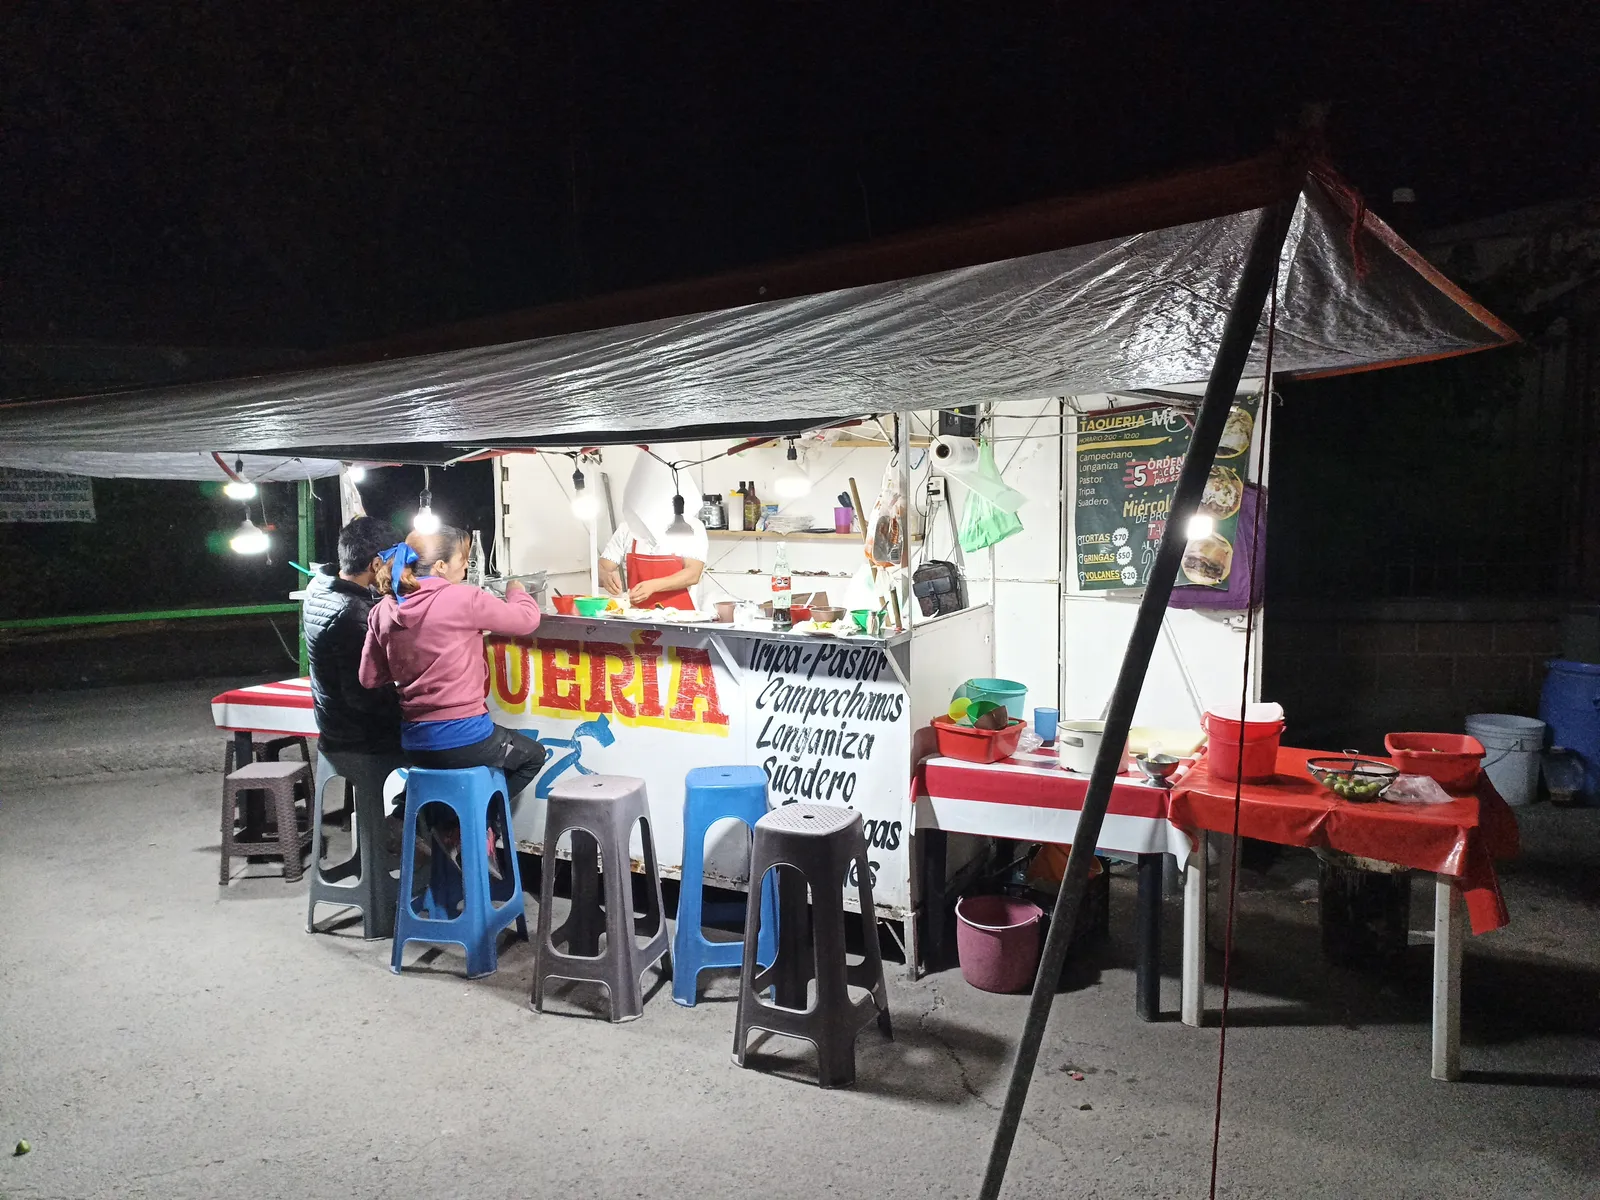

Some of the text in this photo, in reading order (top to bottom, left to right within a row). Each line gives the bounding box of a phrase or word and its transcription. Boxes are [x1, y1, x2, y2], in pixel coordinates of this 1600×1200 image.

[1080, 415, 1146, 432] TAQUERIA
[1079, 451, 1133, 463] Campechano
[1079, 462, 1119, 473] Longaniza
[1152, 464, 1181, 479] TACOS
[1079, 476, 1103, 485] Pastor
[1133, 465, 1147, 486] 5
[1153, 477, 1168, 487] por
[1078, 488, 1096, 498] Tripa
[1078, 498, 1109, 507] Suadero
[1123, 494, 1172, 518] Miércol
[1135, 513, 1148, 524] DE
[1148, 524, 1161, 536] TA
[1081, 533, 1111, 543] TORTAS
[1114, 534, 1127, 542] $70
[1084, 553, 1115, 563] GRINGAS
[1118, 552, 1131, 560] $50
[1085, 570, 1120, 580] VOLCANES
[485, 630, 730, 732] UERÍA
[755, 716, 875, 762] Longaniza
[763, 756, 857, 803] Suadero
